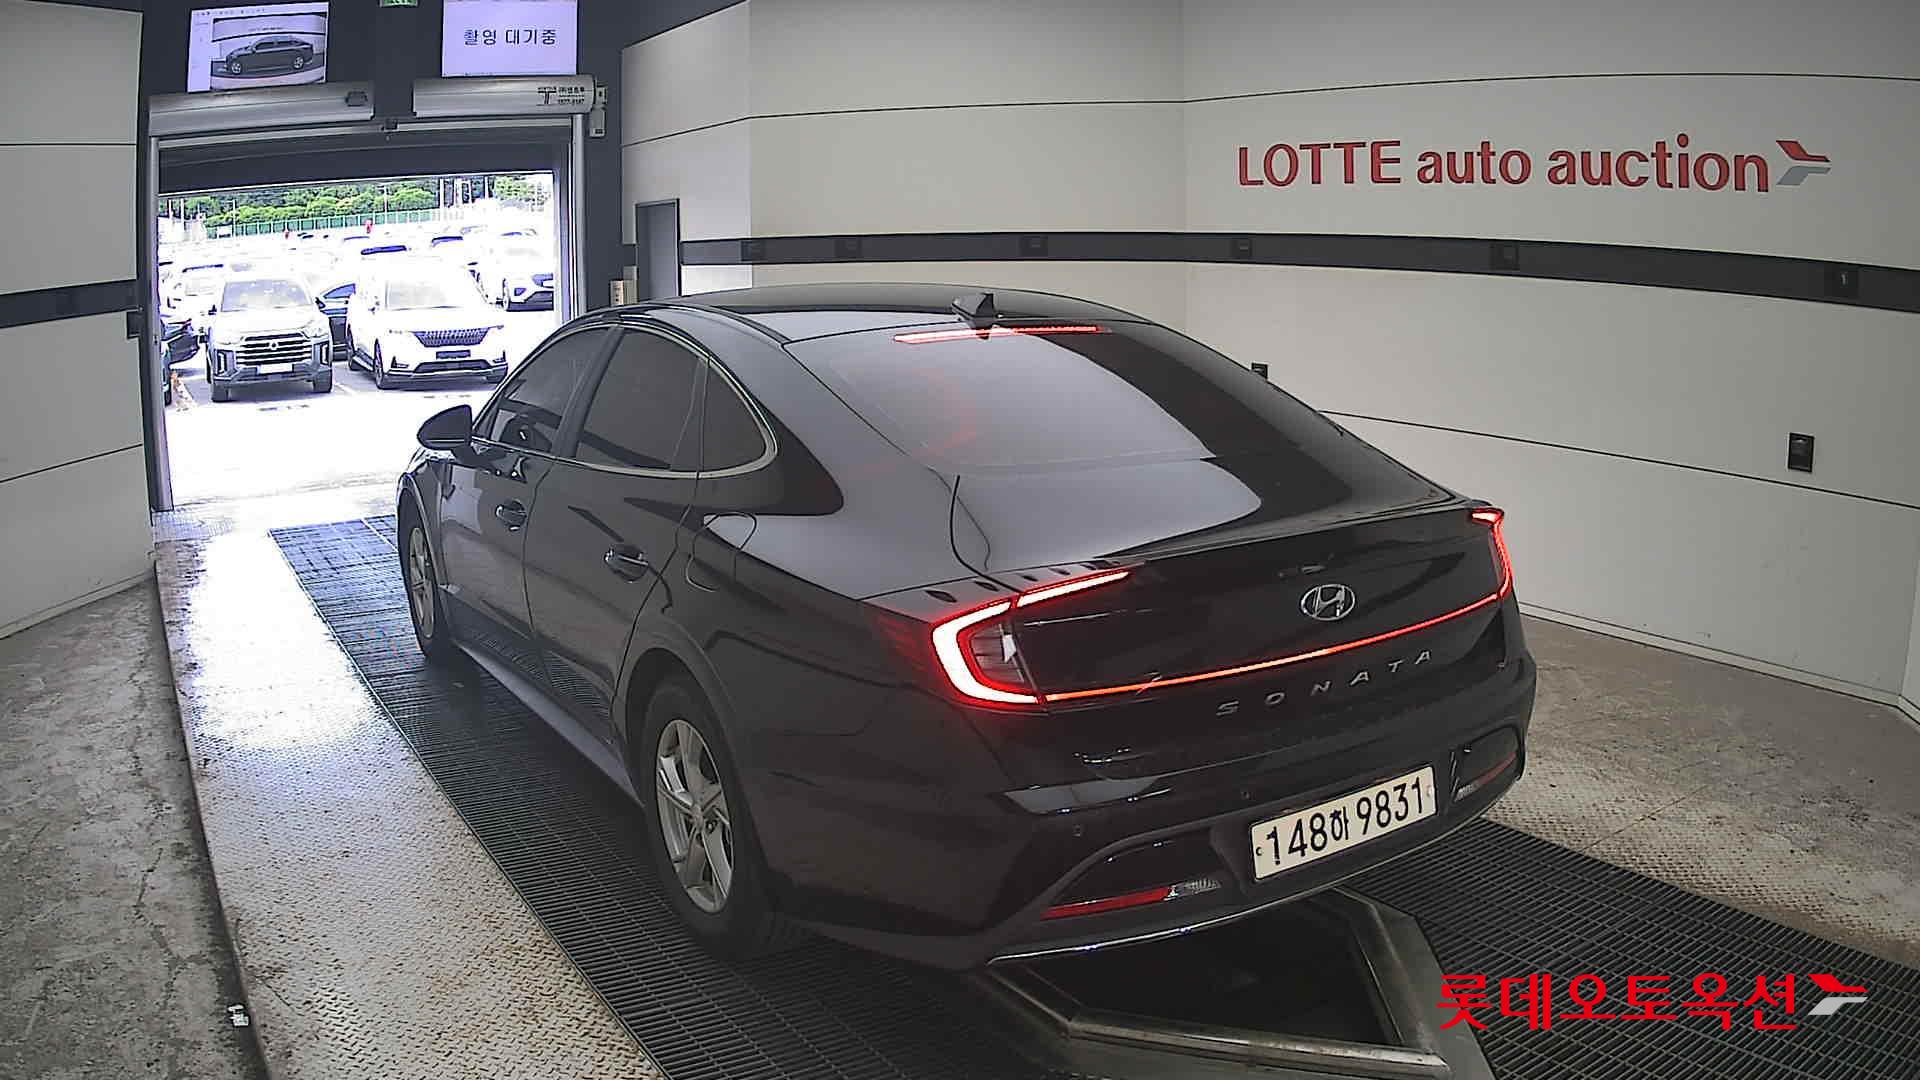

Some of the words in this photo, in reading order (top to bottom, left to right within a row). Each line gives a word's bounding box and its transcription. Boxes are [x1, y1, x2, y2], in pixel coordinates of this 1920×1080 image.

[505, 29, 556, 45] 대기중
[1239, 141, 1401, 187] LOTTE
[1417, 141, 1532, 185] auto
[1547, 133, 1769, 193] auction
[1215, 649, 1432, 717] SONATA
[1266, 806, 1349, 866] 148하
[1356, 776, 1424, 835] 9831
